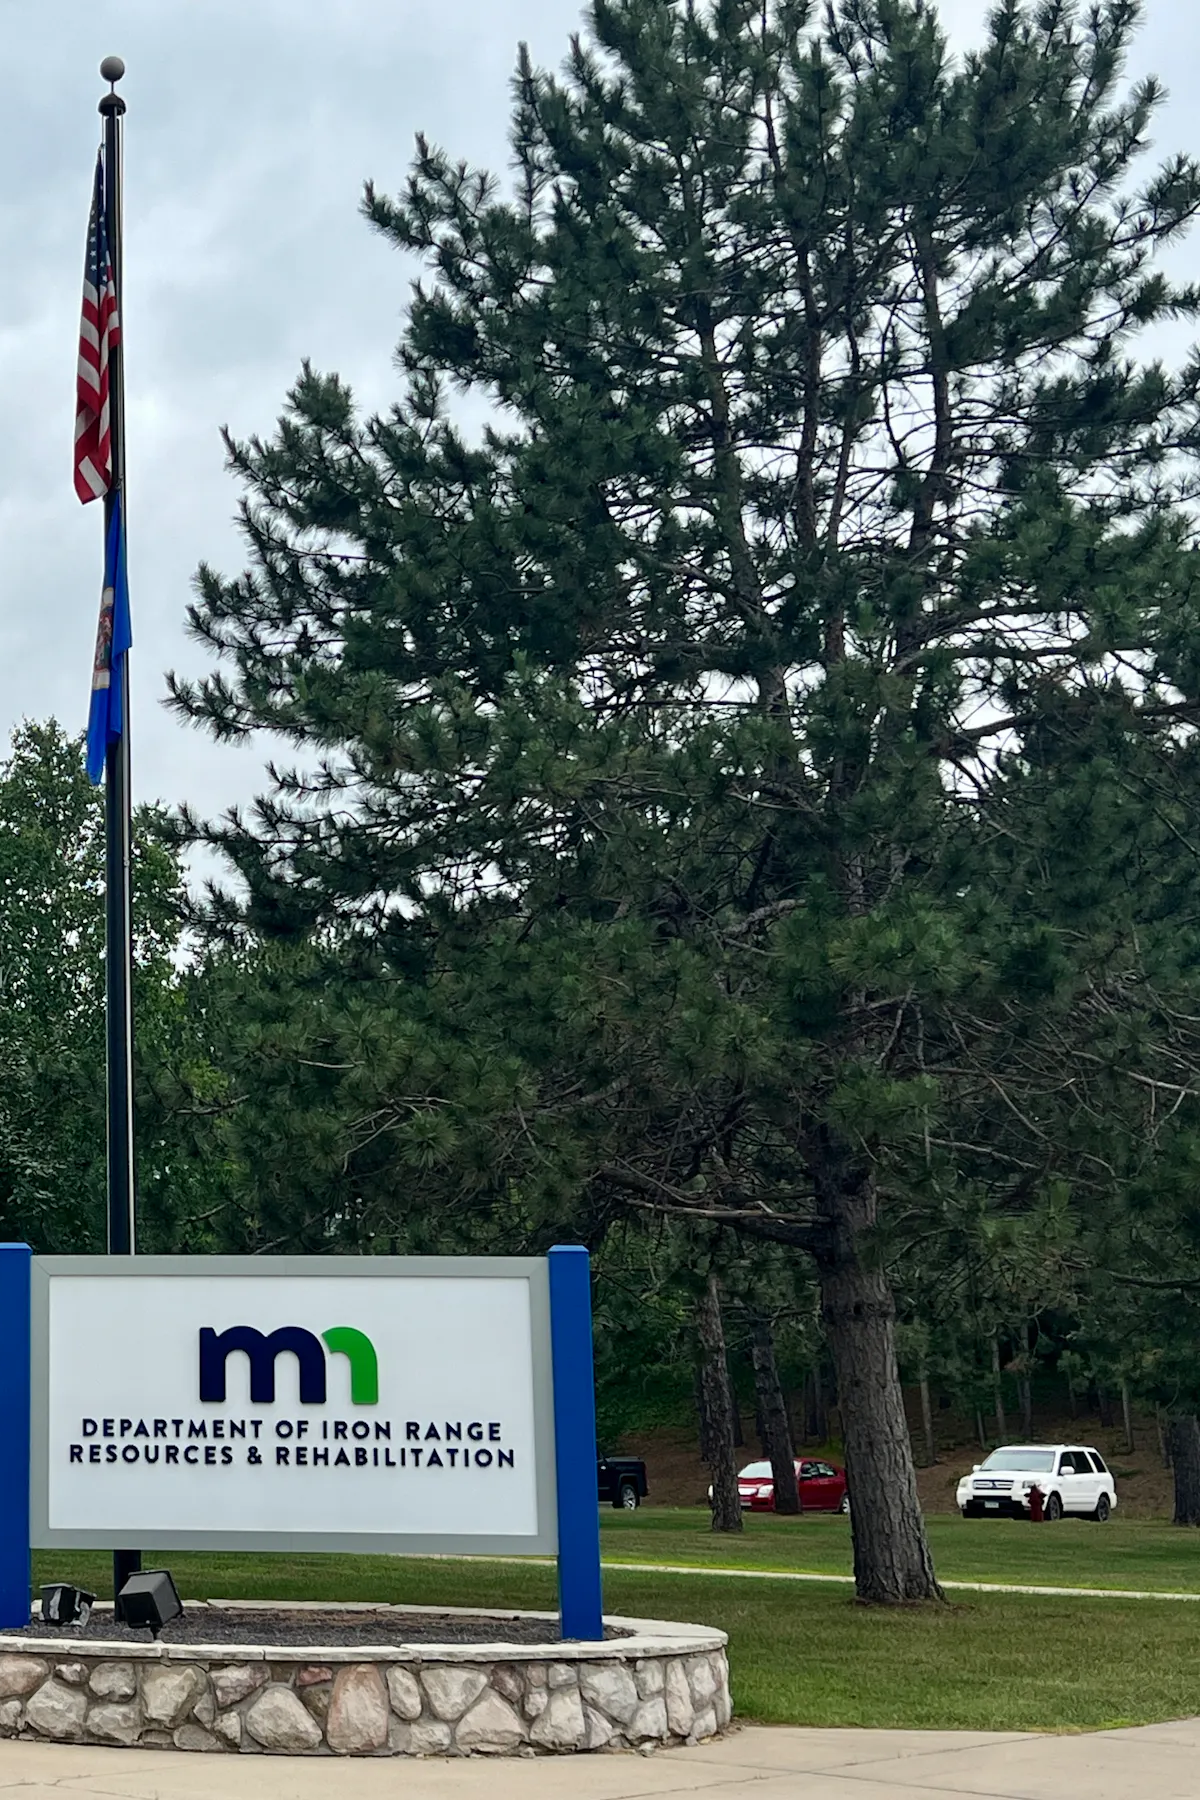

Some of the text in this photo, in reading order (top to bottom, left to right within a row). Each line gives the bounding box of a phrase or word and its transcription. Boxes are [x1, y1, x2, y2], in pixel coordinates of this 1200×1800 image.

[82, 1418, 501, 1442] DEPARTMENT OF IRON RANGE
[69, 1444, 515, 1469] RESOURCES & REHABILITATION
